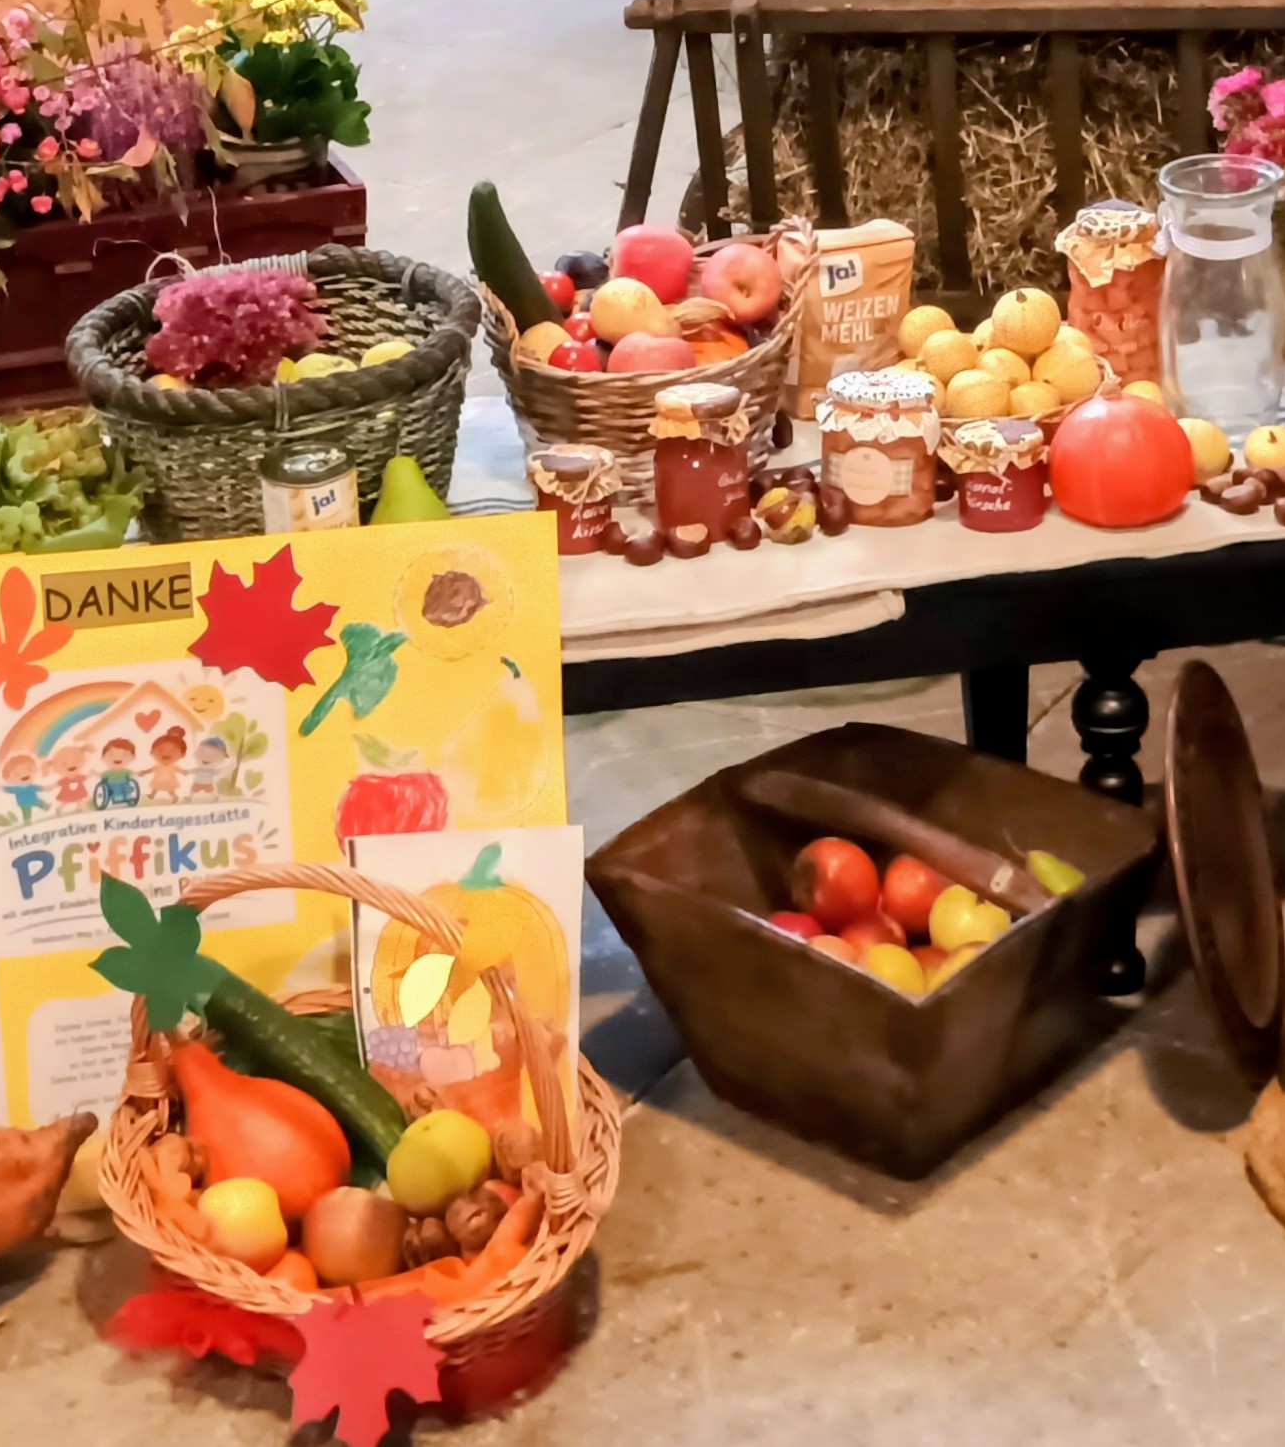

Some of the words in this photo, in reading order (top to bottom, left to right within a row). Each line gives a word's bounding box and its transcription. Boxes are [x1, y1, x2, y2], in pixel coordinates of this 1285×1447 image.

[822, 294, 900, 323] WEIZEN
[821, 320, 874, 344] MEHL
[45, 574, 191, 622] DANKE
[8, 820, 97, 850] Integrative
[104, 807, 250, 831] Kindertagesstätte
[12, 833, 259, 900] Pfiffikus
